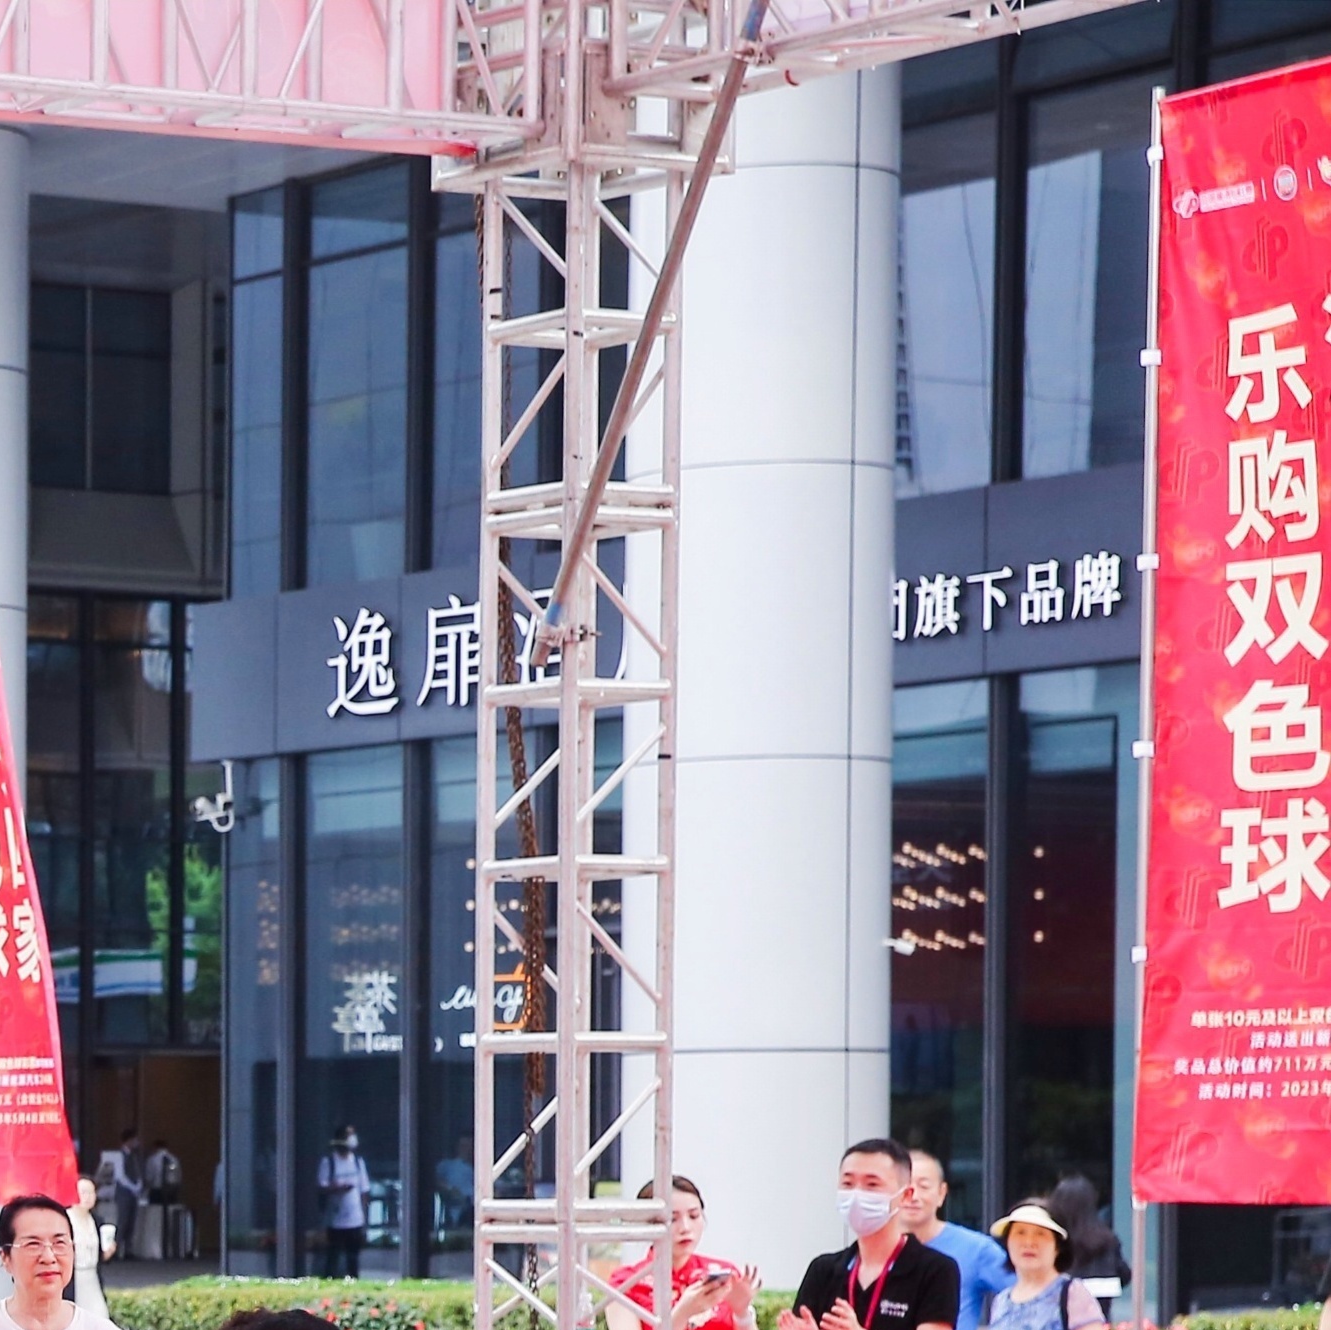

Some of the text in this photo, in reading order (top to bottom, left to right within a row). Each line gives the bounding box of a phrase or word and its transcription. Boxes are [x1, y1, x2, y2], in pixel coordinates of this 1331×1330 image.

[1217, 303, 1331, 913] 乐购双色球
